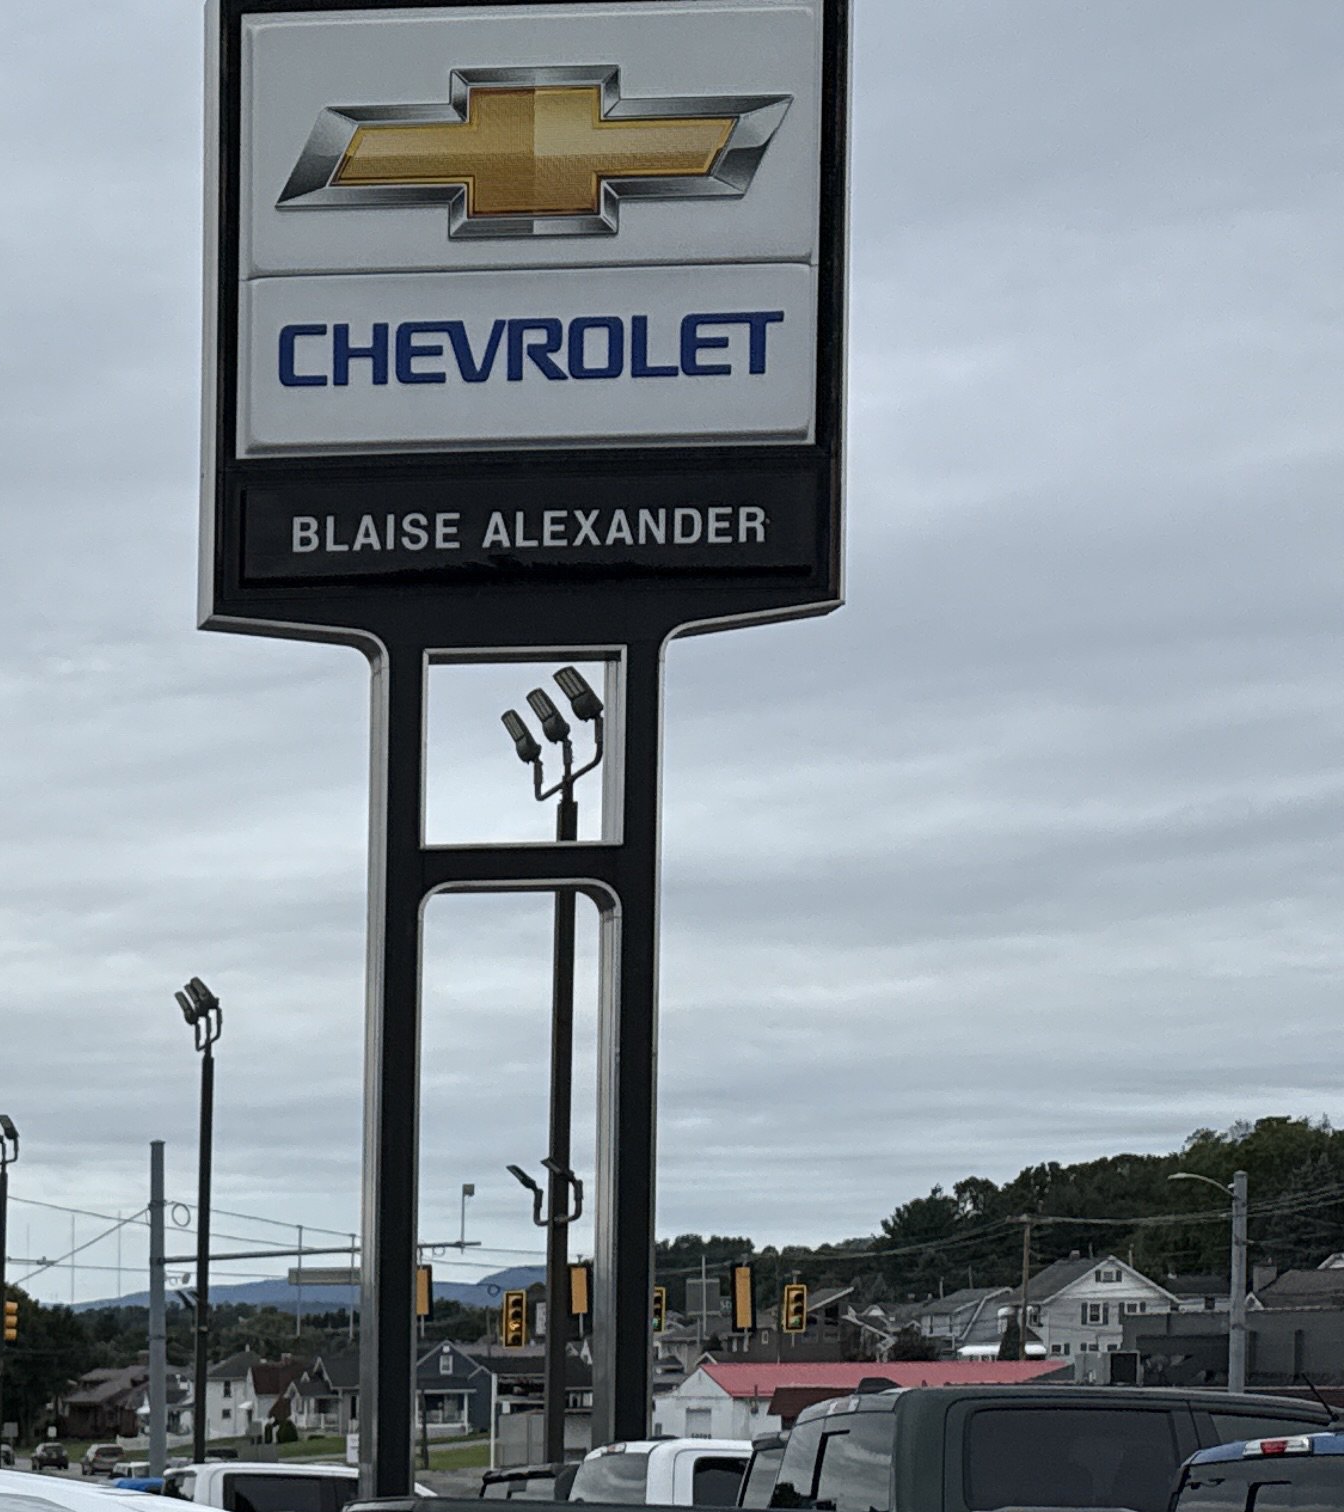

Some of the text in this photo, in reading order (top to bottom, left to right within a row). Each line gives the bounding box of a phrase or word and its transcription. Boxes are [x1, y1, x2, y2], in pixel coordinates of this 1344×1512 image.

[277, 309, 785, 387] CHEVROLET
[291, 505, 766, 553] BLAISE ALEXANDER
